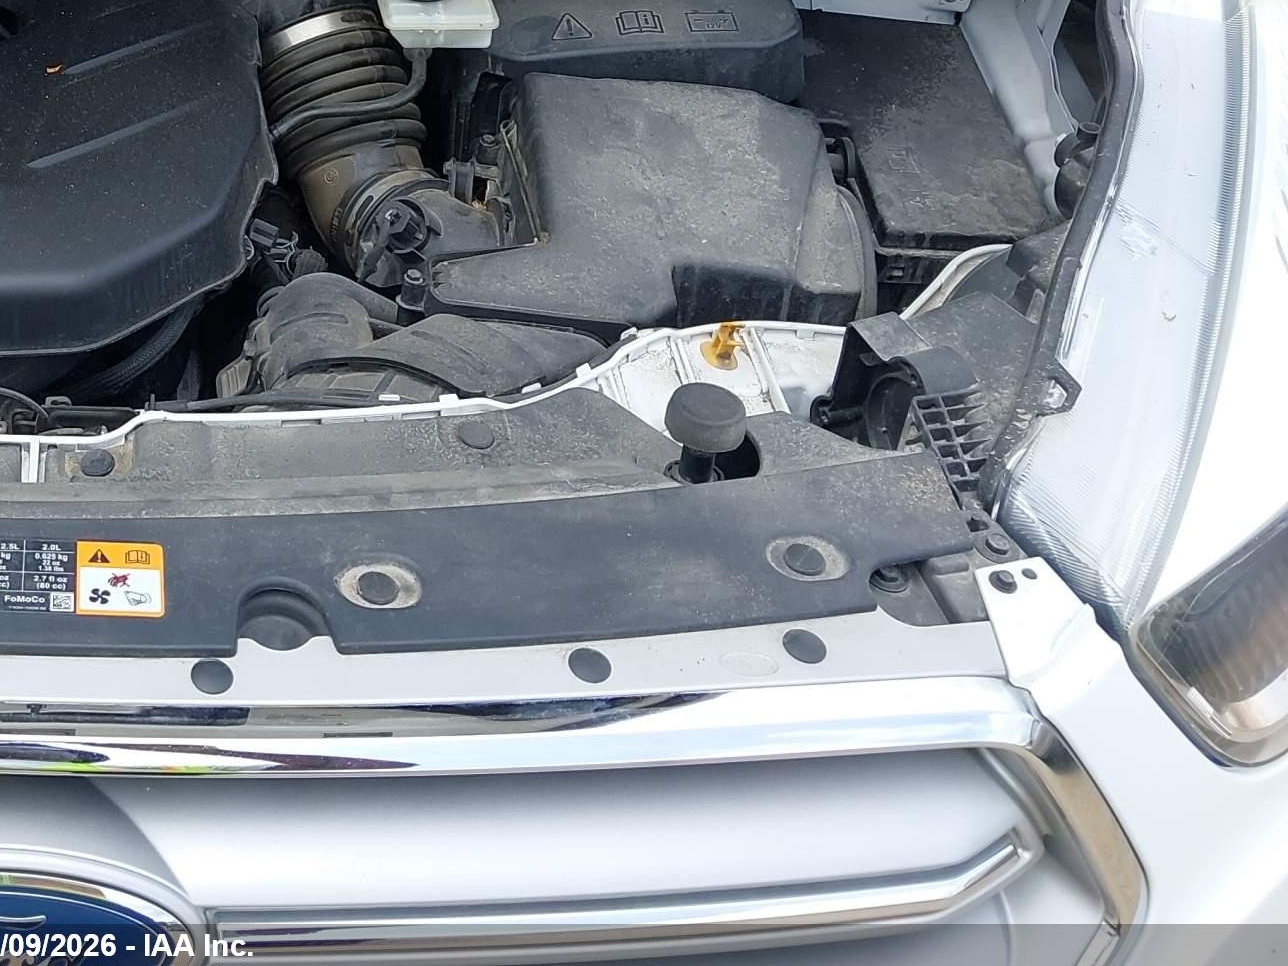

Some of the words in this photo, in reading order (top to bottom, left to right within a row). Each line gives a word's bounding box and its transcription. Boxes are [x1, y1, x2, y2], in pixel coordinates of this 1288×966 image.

[0, 551, 11, 560] kg
[57, 554, 68, 562] kg
[33, 575, 47, 583] 2.7
[36, 582, 50, 590] (80
[52, 583, 66, 591] cc)
[4, 595, 46, 603] FoMoCo
